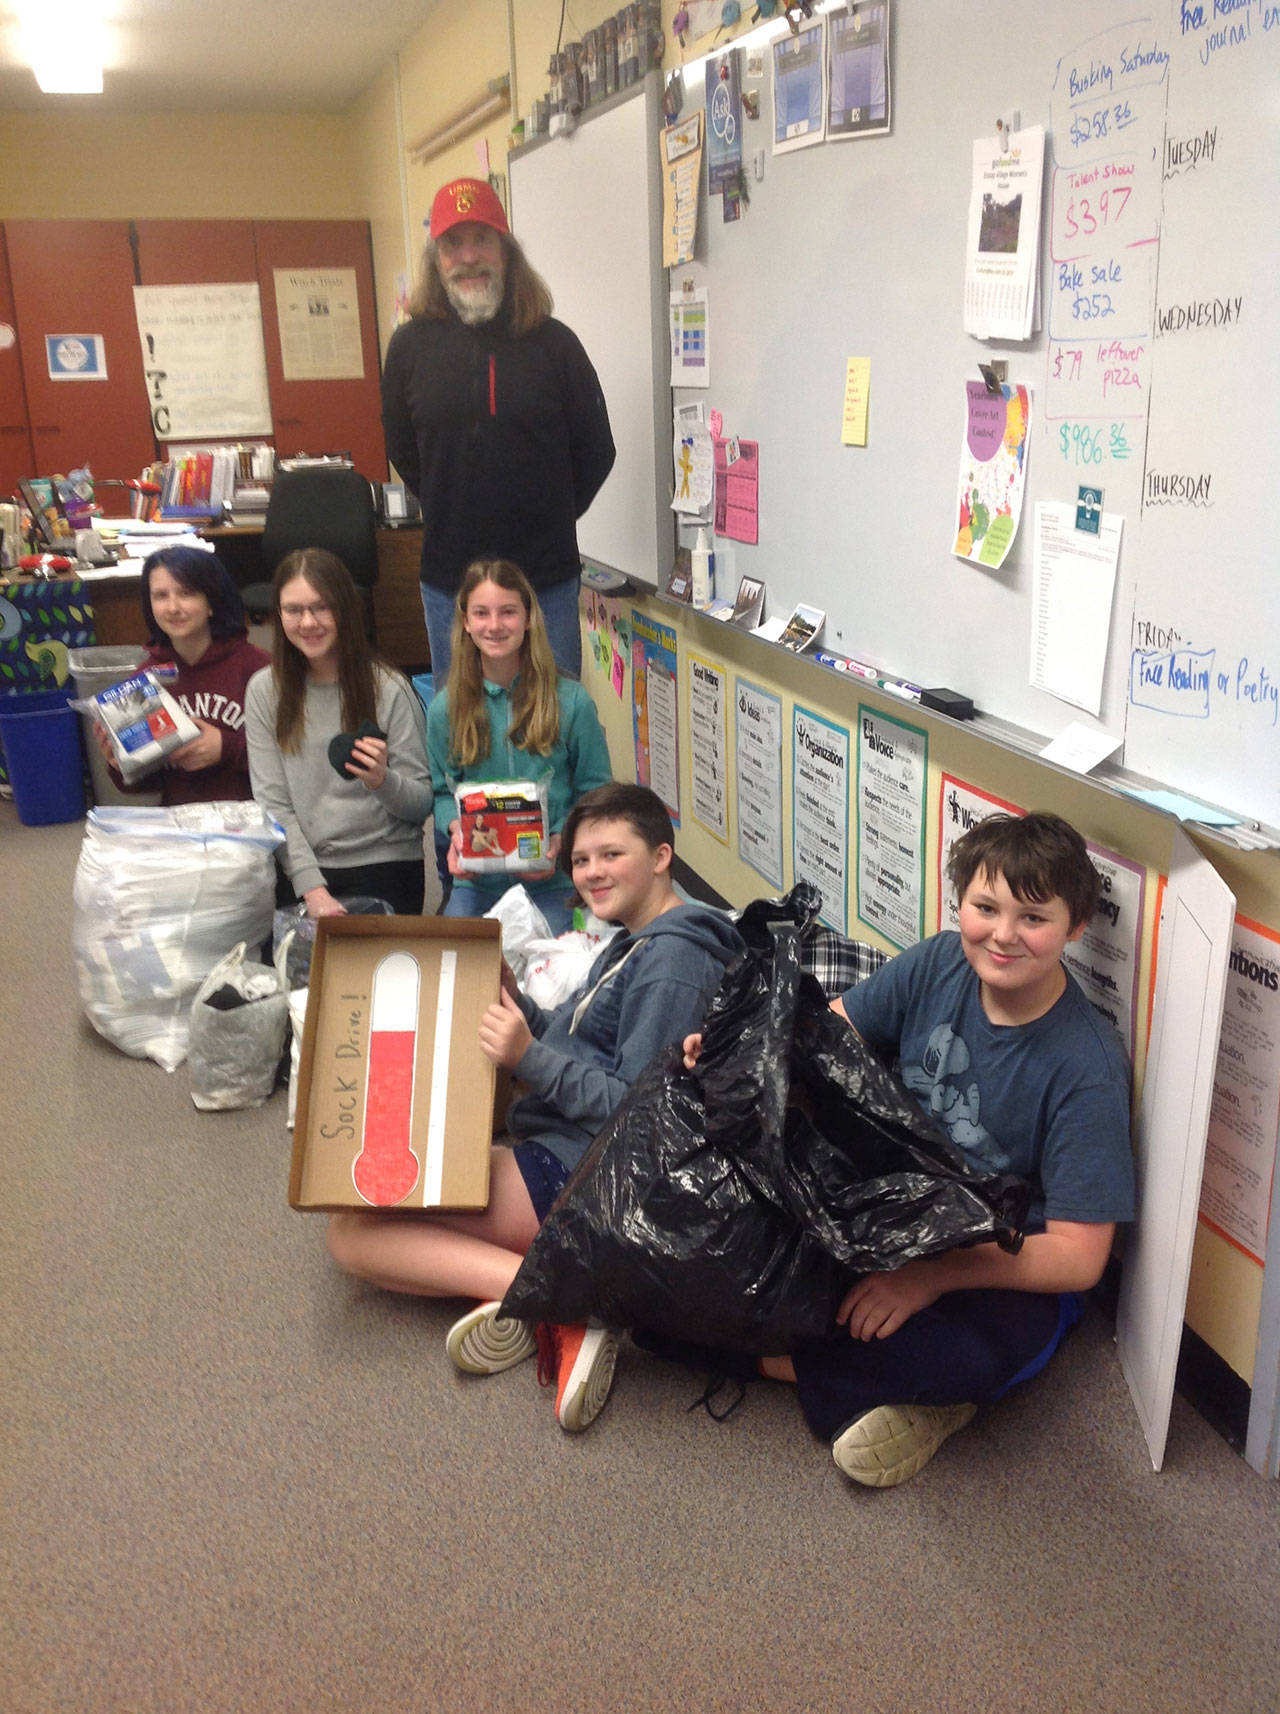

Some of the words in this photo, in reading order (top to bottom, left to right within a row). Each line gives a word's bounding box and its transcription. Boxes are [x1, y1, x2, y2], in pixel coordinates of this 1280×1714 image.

[1200, 9, 1251, 66] journal
[1070, 61, 1113, 97] Busking
[1120, 42, 1170, 83] Saturday
[1167, 127, 1217, 169] TUESDAY
[1067, 168, 1098, 189] Talent
[1102, 164, 1135, 178] Show
[1064, 187, 1132, 238] $397
[1059, 263, 1083, 291] Bake
[1072, 292, 1116, 320] $252
[1158, 297, 1243, 332] WEDNESDAY
[1096, 340, 1144, 362] leftover
[1103, 368, 1143, 398] pizza
[1147, 470, 1212, 500] THURSDAY
[1218, 673, 1230, 695] or
[1237, 657, 1279, 727] Poetry
[805, 733, 844, 769] Organization
[875, 733, 894, 760] Voice
[320, 1076, 358, 1140] Sock
